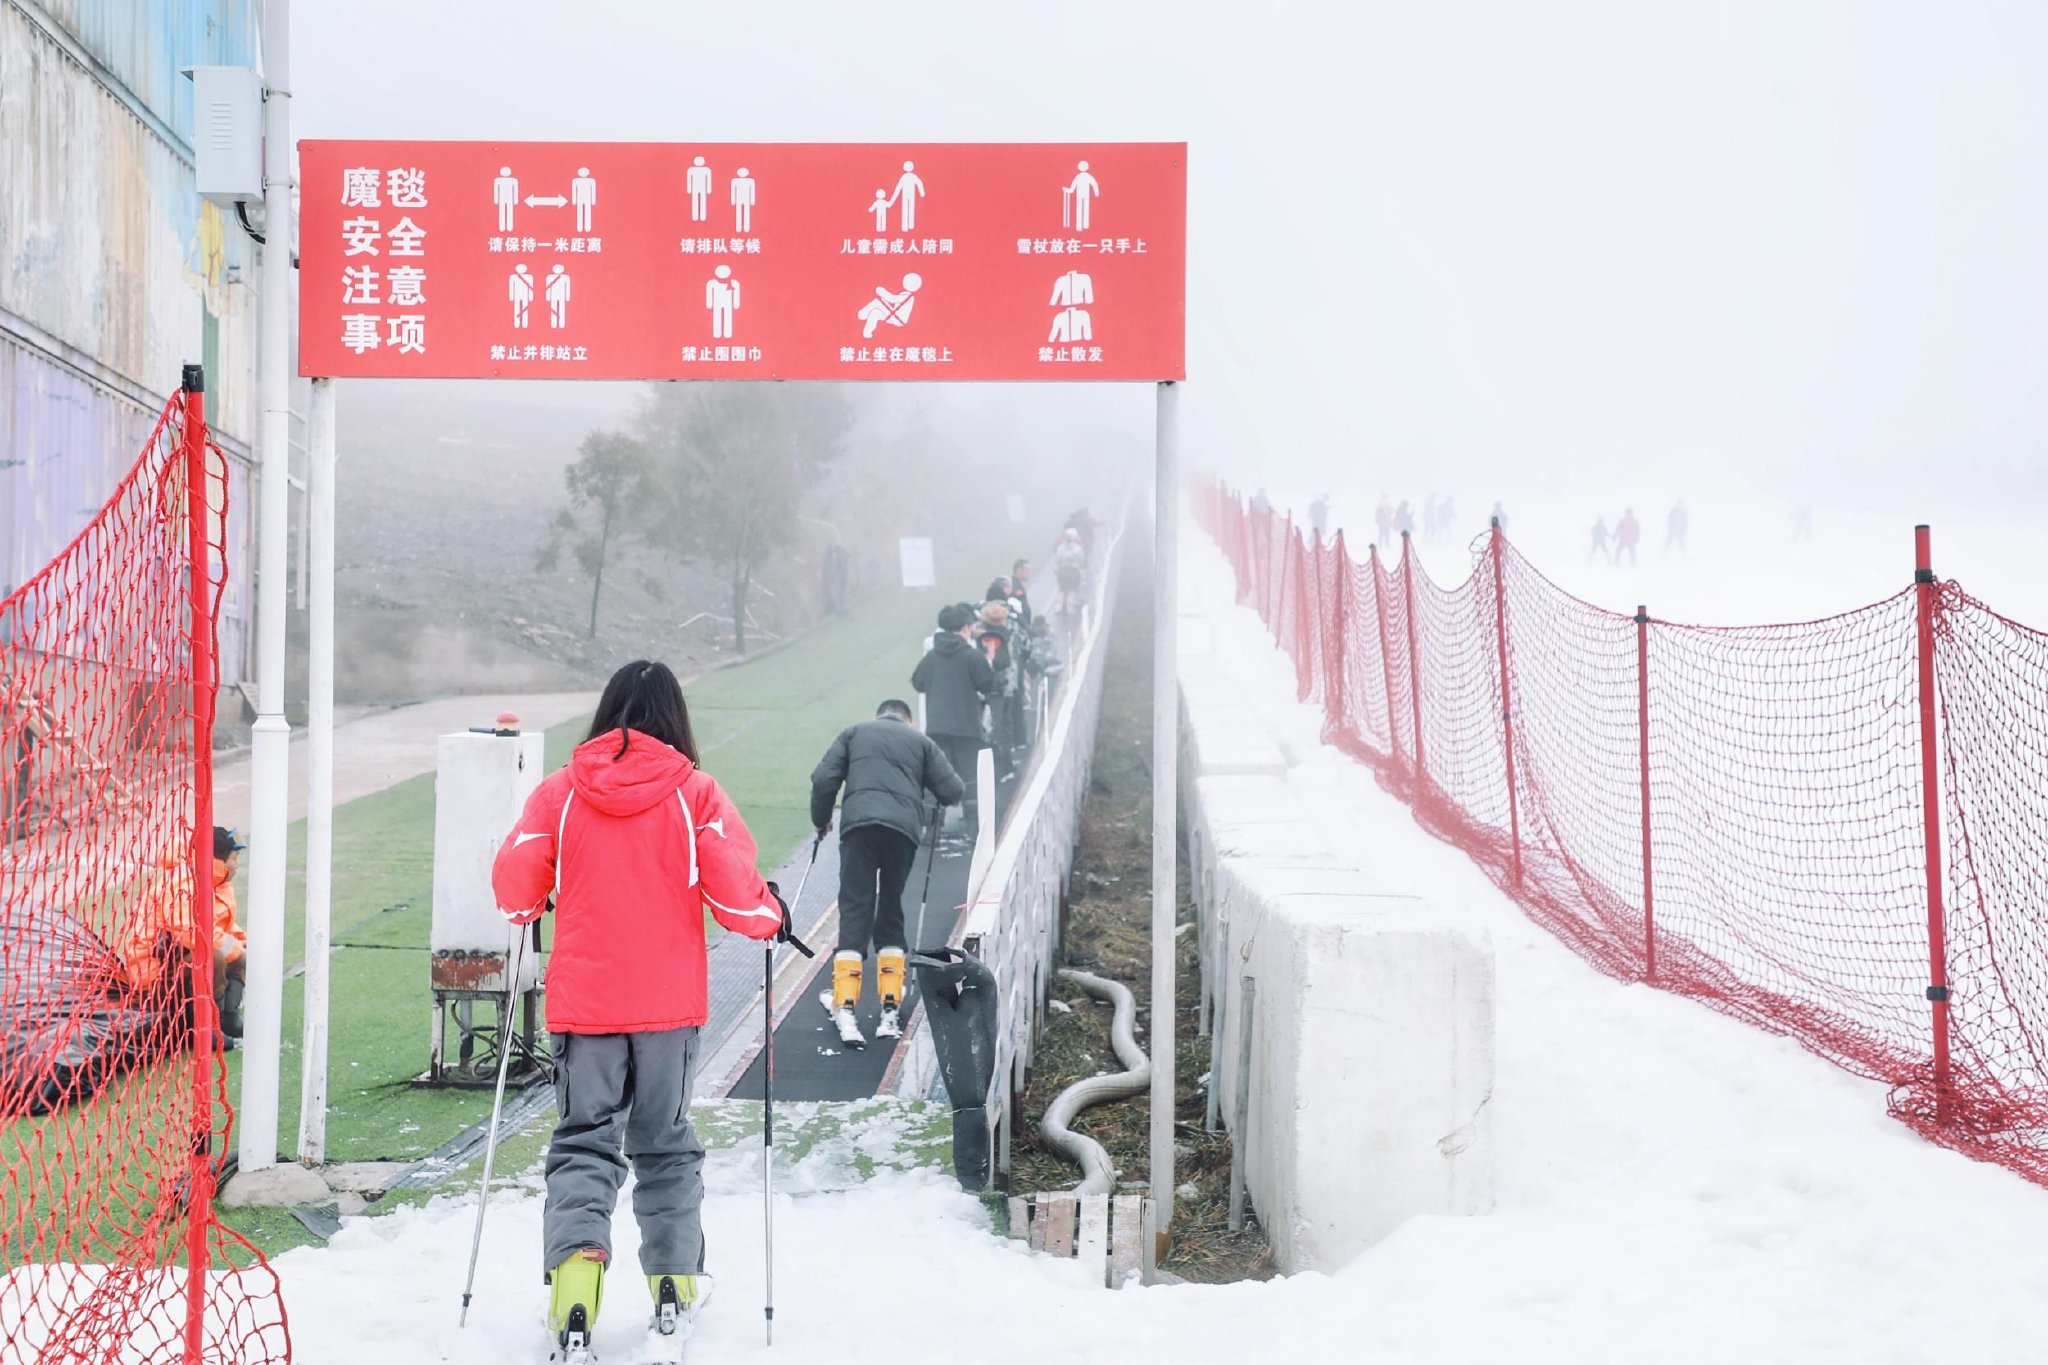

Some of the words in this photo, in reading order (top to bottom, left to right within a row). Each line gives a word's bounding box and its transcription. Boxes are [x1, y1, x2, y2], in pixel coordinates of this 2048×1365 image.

[341, 167, 427, 207] 魔毯
[342, 216, 426, 256] 安全
[488, 237, 602, 252] 请保持一米距离
[681, 238, 760, 253] 请排队等候
[841, 239, 953, 254] 儿童需成人陪同
[1017, 238, 1147, 254] 雪杖放在一只手上
[342, 265, 426, 305] 注意
[341, 314, 426, 354] 事项
[491, 345, 588, 360] 禁止并排站立
[681, 346, 761, 361] 禁止围围巾
[840, 347, 953, 362] 禁止坐在魔毯上
[1038, 347, 1103, 362] 禁止散发
